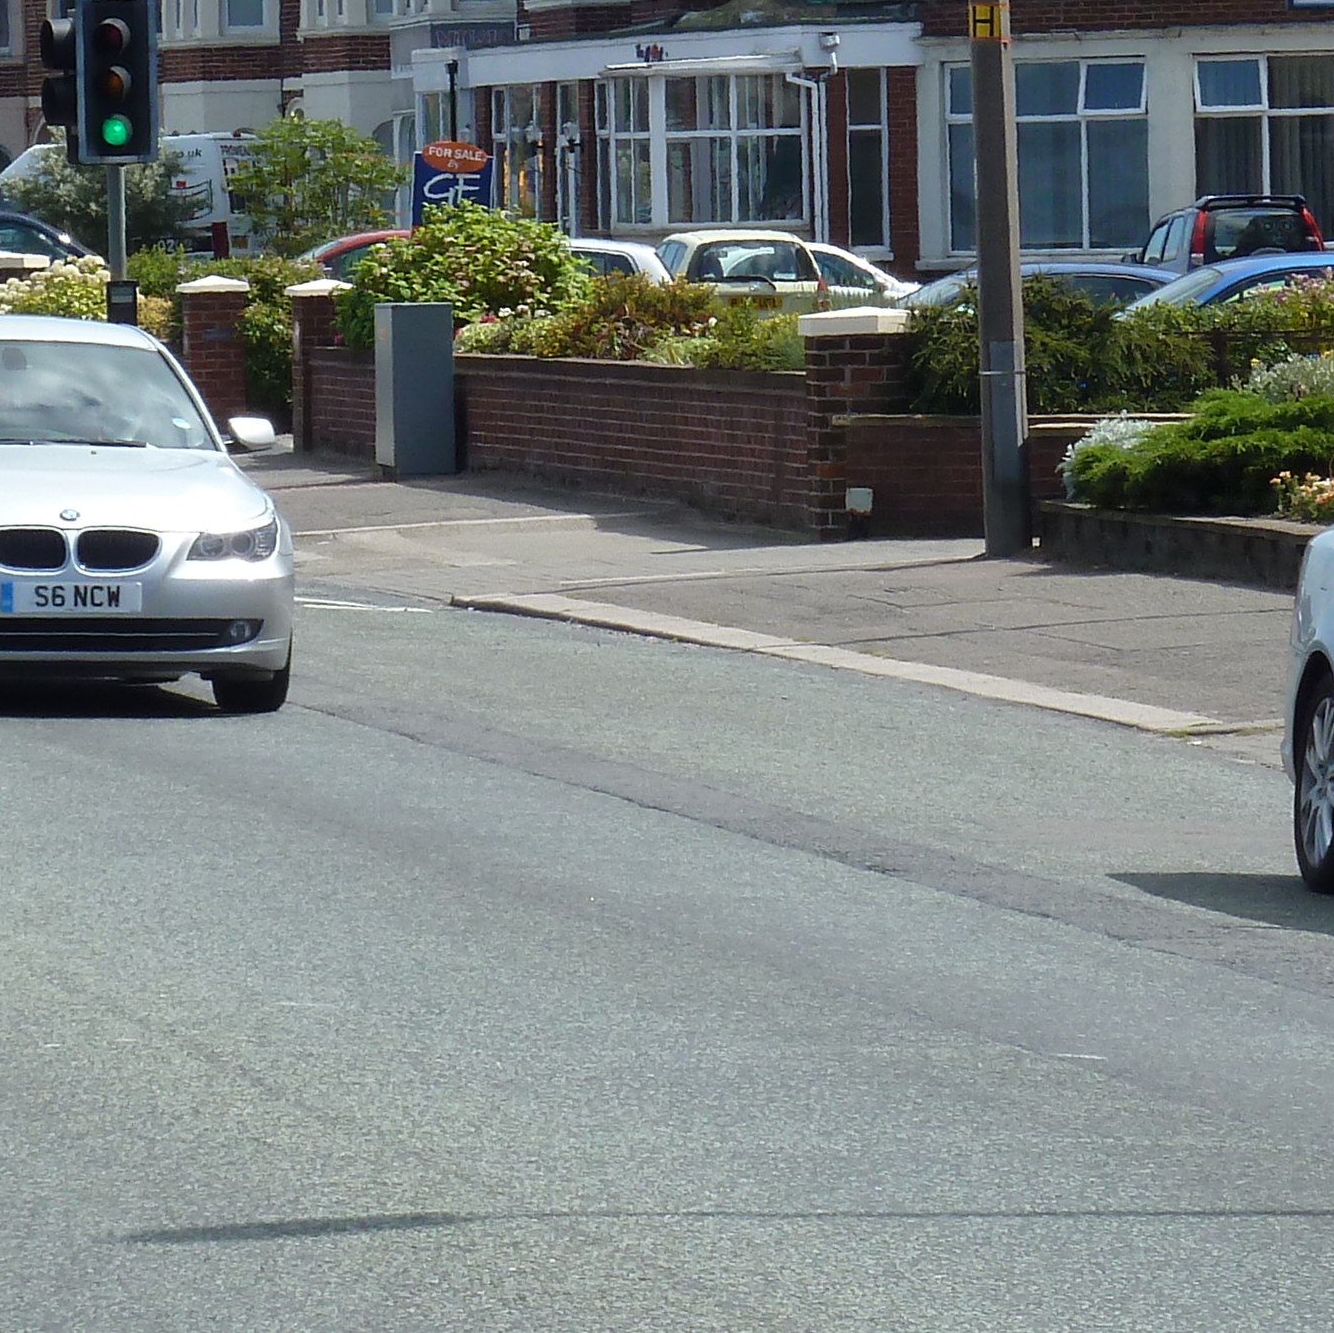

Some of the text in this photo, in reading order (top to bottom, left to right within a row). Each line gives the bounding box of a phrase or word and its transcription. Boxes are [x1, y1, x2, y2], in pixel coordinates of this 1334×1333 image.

[972, 5, 995, 38] H
[428, 145, 485, 162] FOR SALE
[34, 584, 121, 608] S6 NCW
